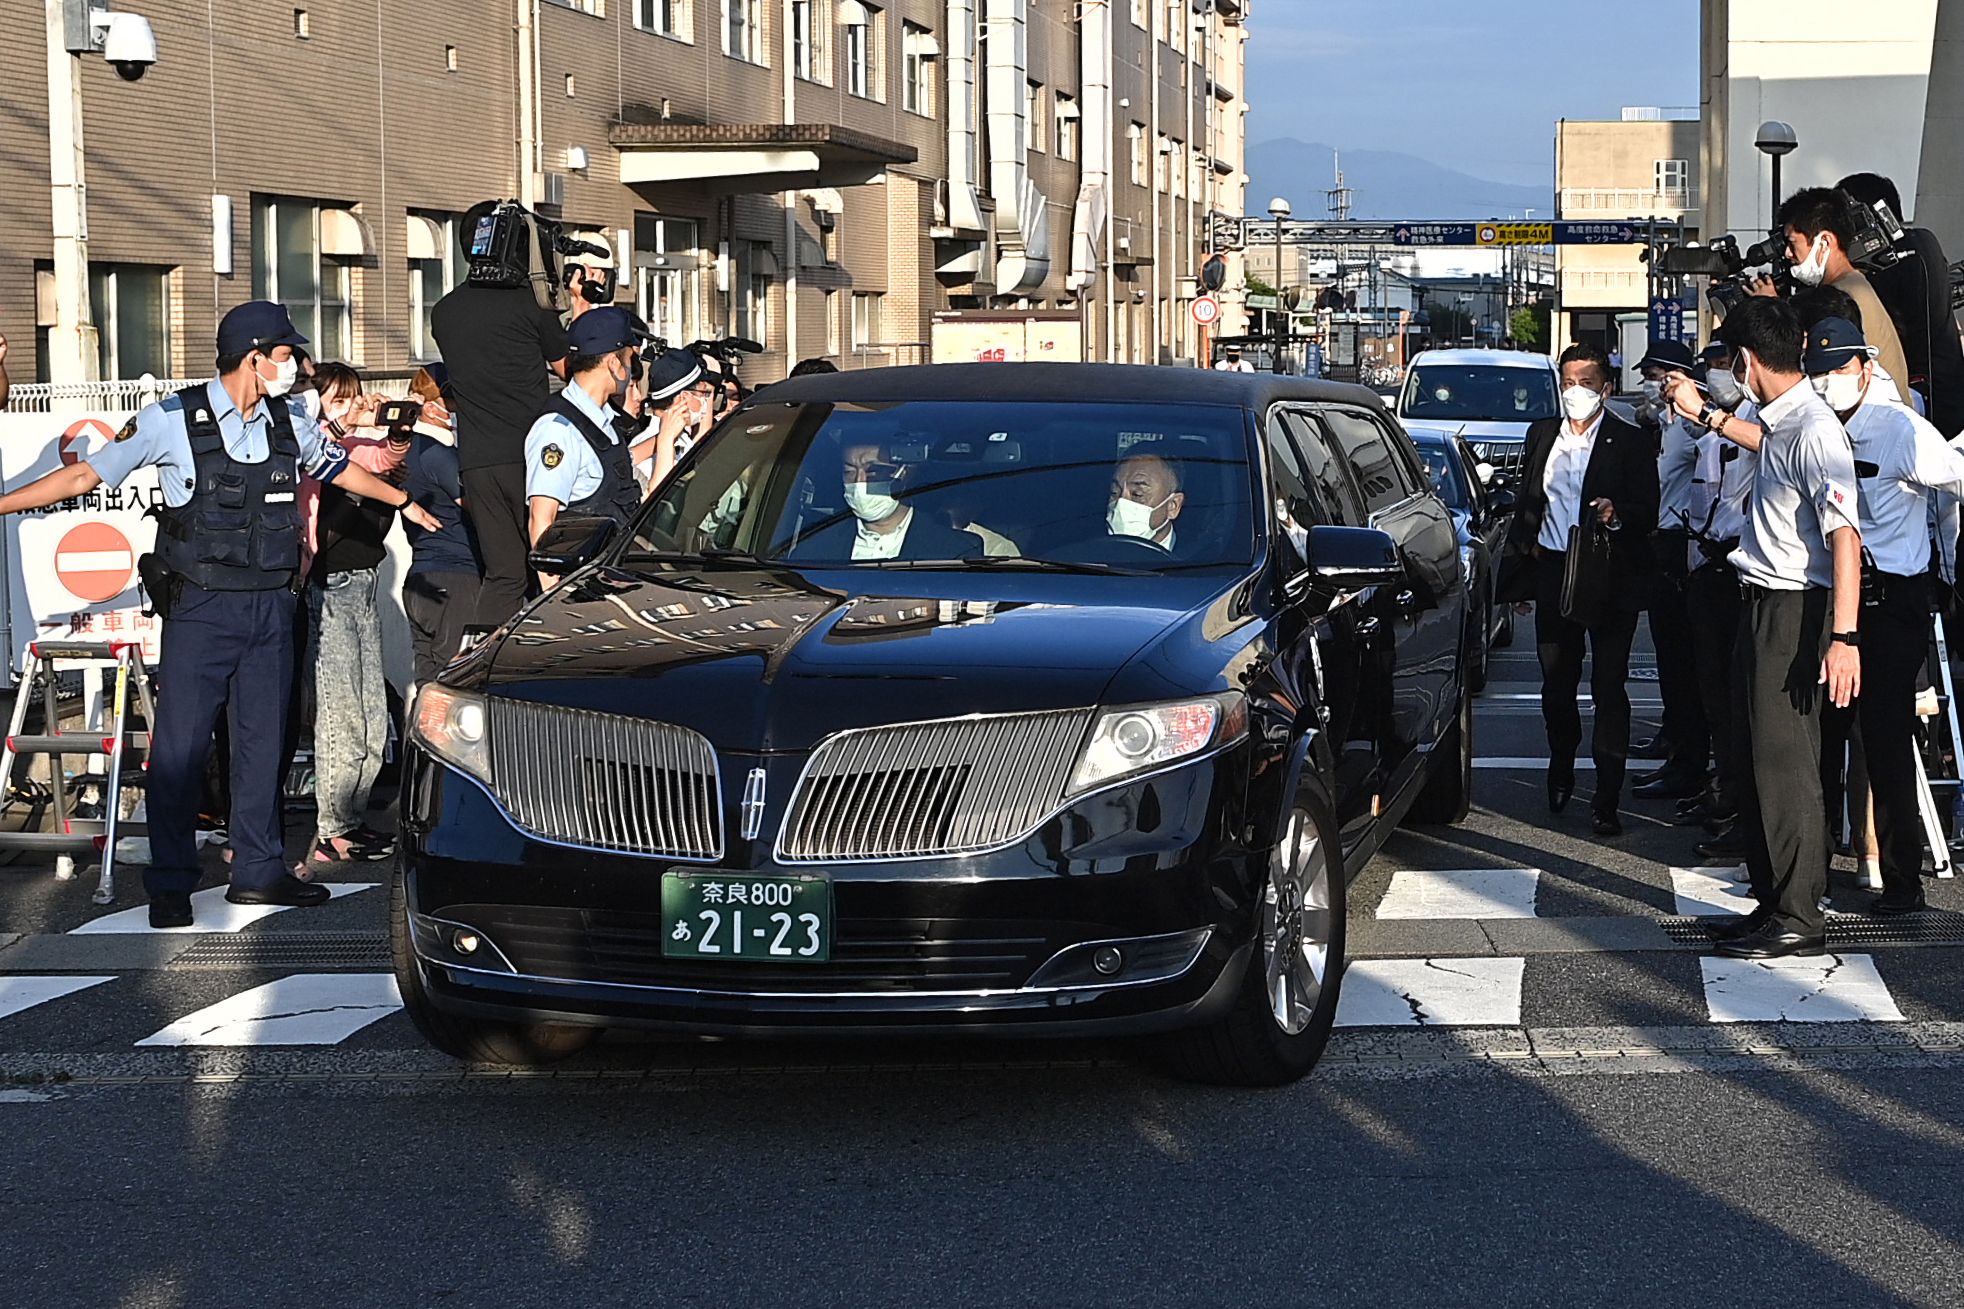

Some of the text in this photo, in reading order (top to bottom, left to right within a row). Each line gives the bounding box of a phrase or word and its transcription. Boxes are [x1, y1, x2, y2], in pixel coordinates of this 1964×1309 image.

[1499, 229, 1549, 239] 高さ制限4M
[1585, 235, 1618, 243] センター
[1199, 305, 1212, 316] 10
[39, 609, 156, 635] 一般車両
[701, 881, 793, 907] 奈良800
[671, 909, 821, 957] あ 21-23
